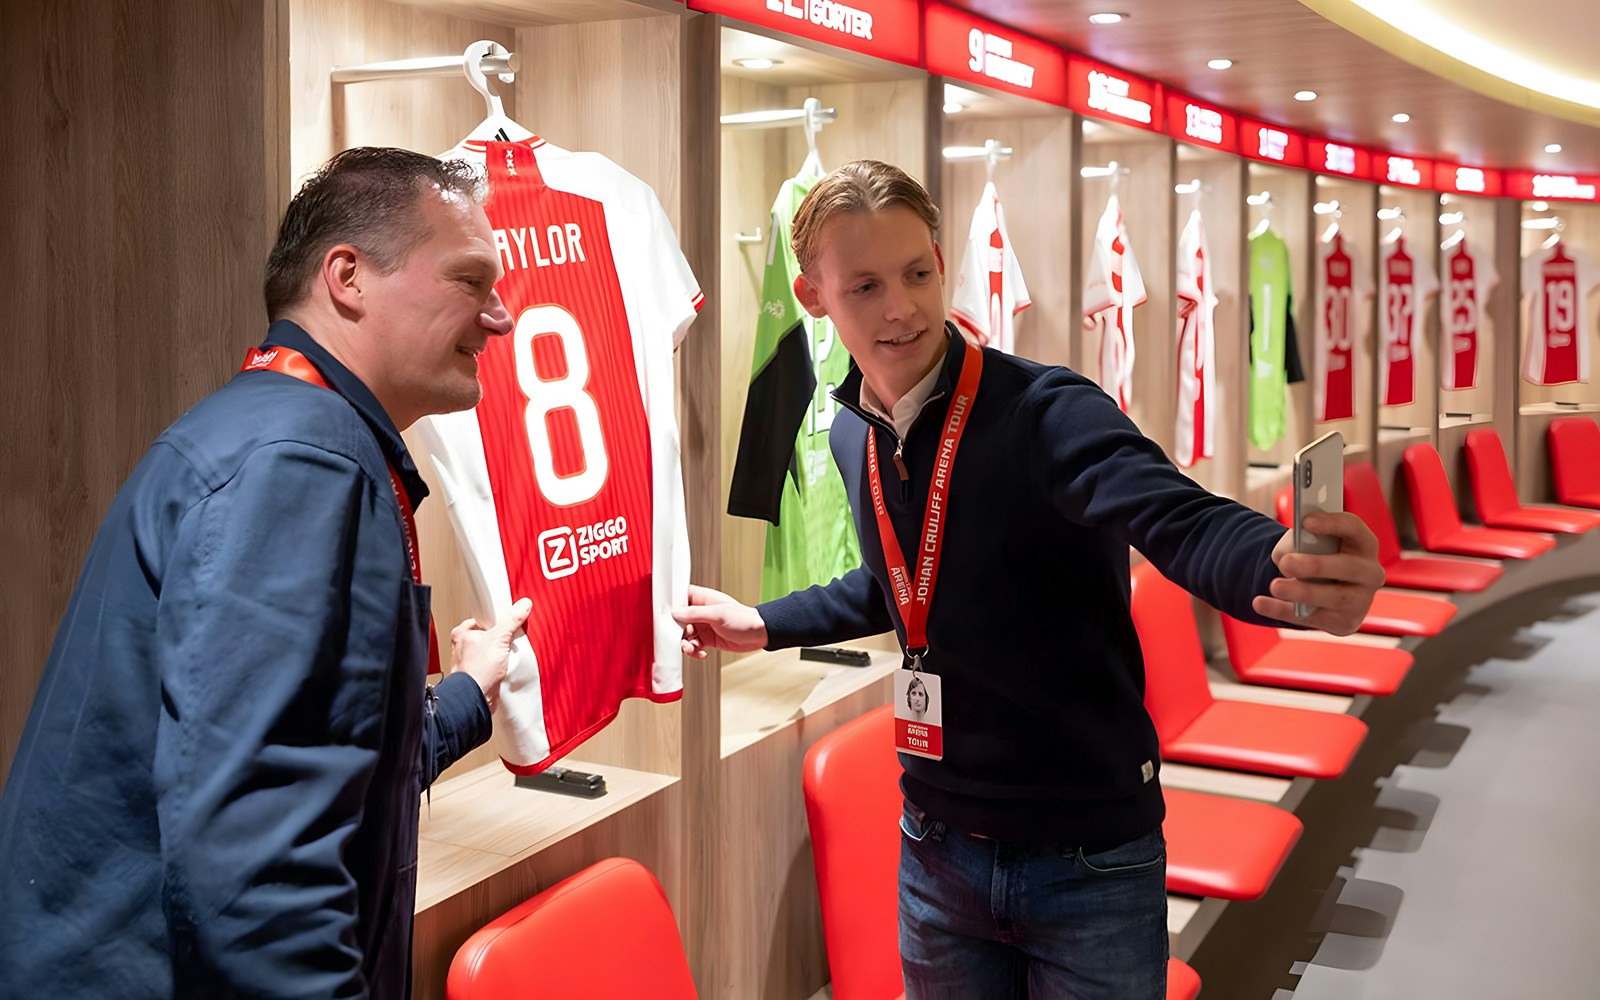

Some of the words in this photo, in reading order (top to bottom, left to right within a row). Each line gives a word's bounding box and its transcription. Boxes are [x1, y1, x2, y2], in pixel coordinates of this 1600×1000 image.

[809, 0, 873, 40] GORTER
[968, 28, 984, 73] 9
[492, 223, 586, 271] AYLOR
[1546, 280, 1575, 332] 19
[513, 303, 609, 509] 8
[916, 556, 934, 605] JOHAN
[935, 438, 955, 489] ARENA
[947, 394, 969, 434] TOUR
[576, 516, 627, 546] ZIGGO
[580, 535, 628, 566] SPORT
[890, 567, 910, 606] ARENA
